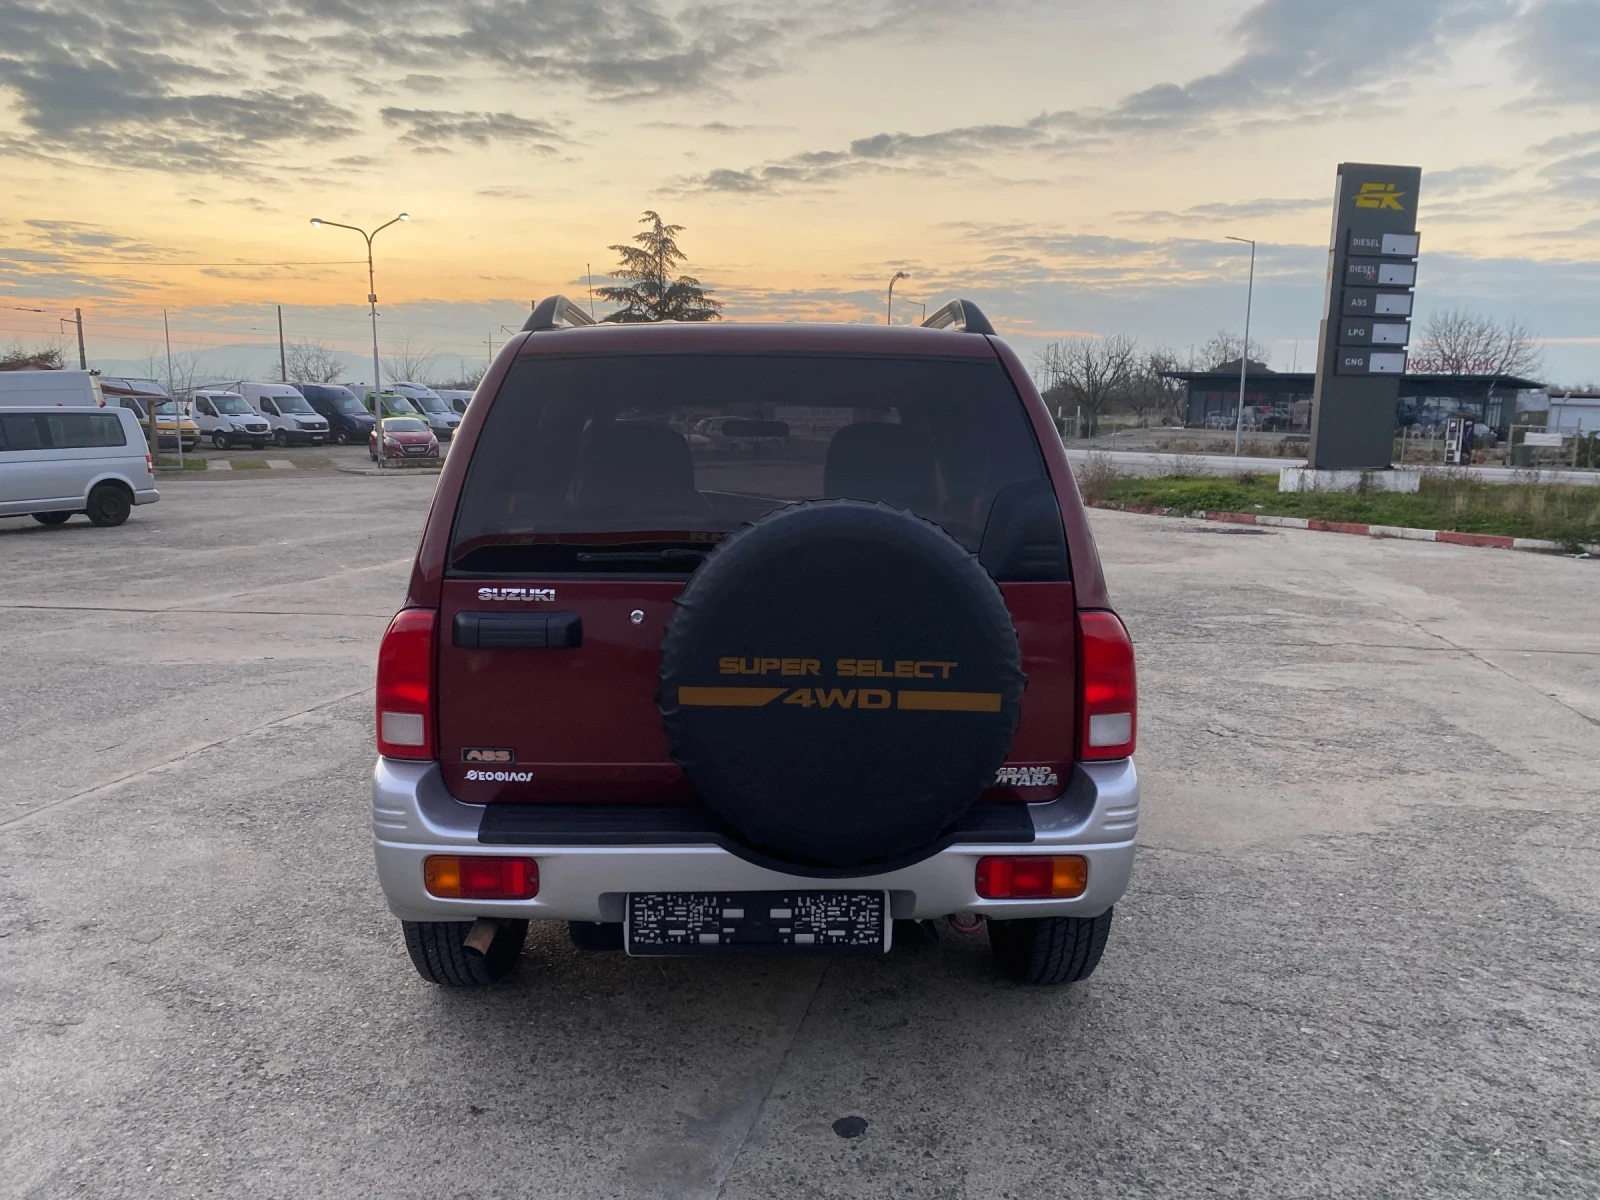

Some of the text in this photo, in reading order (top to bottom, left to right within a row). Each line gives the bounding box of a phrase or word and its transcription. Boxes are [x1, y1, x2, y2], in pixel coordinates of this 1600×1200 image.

[1353, 238, 1380, 247] DIESEL
[1349, 264, 1375, 274] DIESEL
[1351, 299, 1367, 307] A95
[1348, 329, 1365, 337] LPG
[1345, 358, 1363, 366] CNG
[477, 587, 555, 601] SUZUKI
[719, 656, 958, 679] SUPER SELECT
[783, 688, 891, 709] 4WD
[466, 749, 511, 761] ABS
[995, 766, 1052, 776] GRAND
